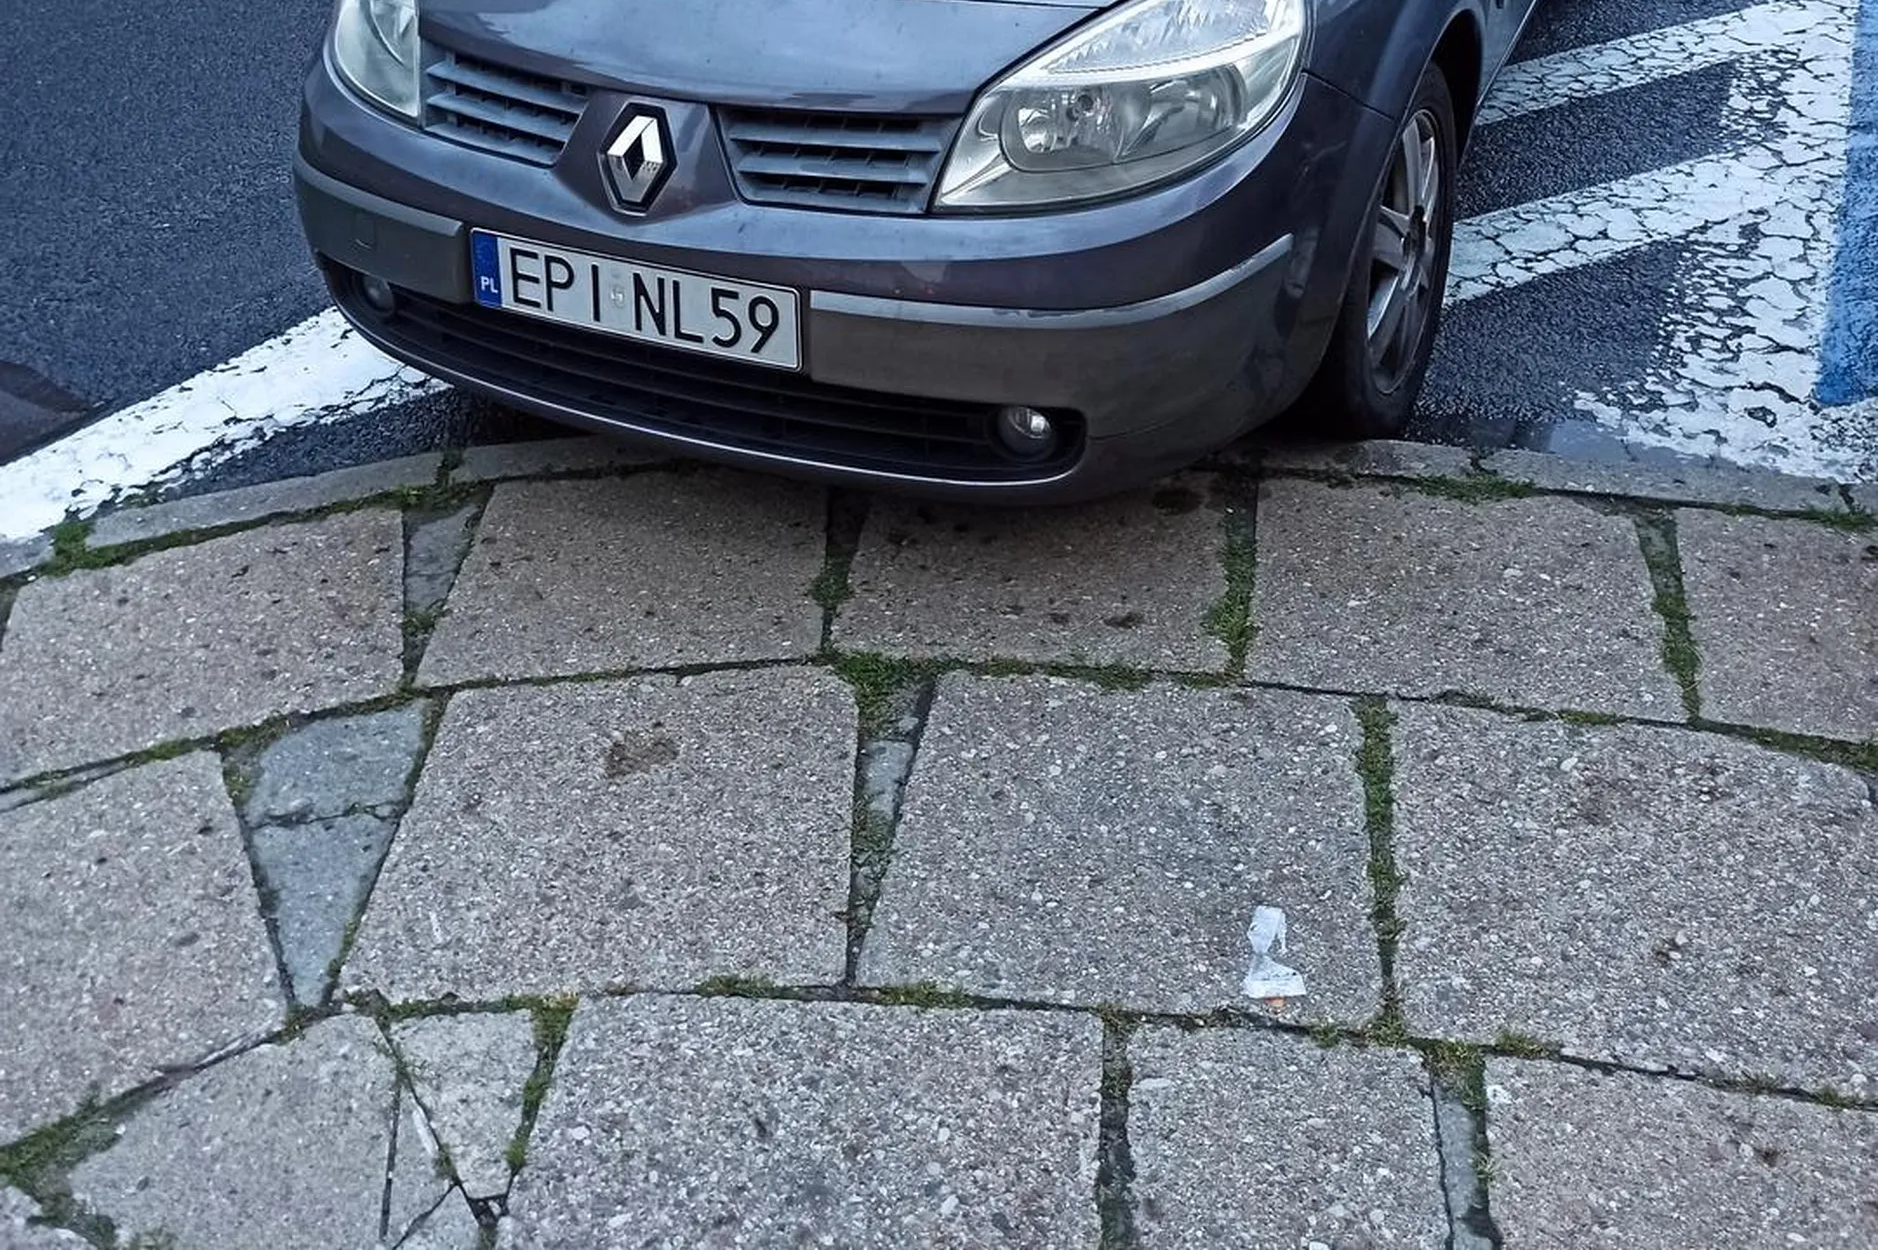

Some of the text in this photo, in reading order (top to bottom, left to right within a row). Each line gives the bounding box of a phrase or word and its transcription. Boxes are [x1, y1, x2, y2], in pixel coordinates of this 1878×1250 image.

[480, 276, 499, 294] PL
[510, 247, 780, 354] EPI NL59
